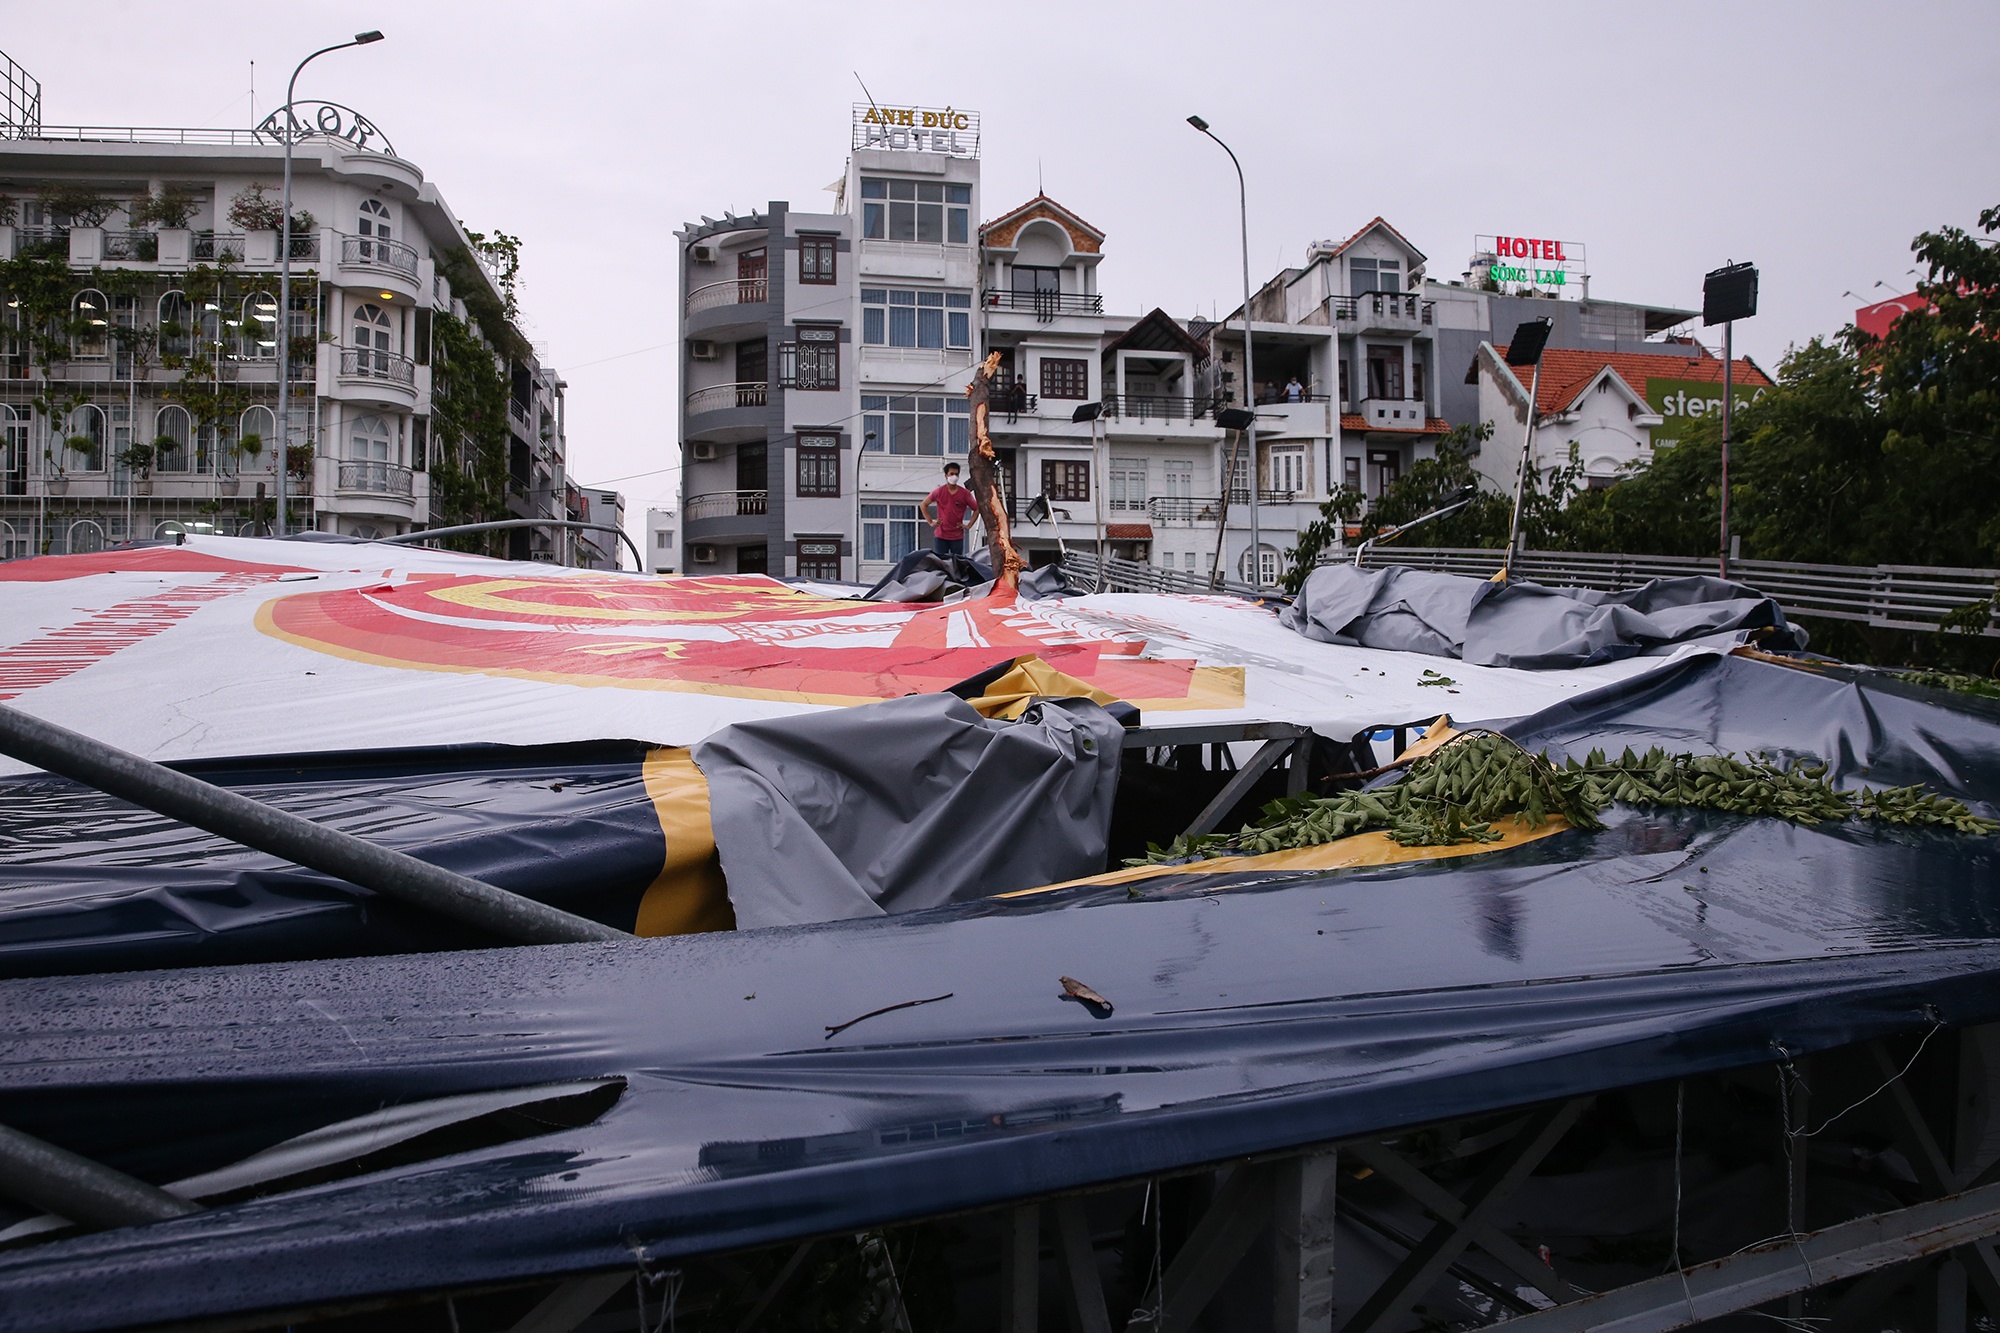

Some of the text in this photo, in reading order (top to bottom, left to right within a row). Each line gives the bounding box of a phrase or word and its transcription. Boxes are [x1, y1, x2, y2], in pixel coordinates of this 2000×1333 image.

[862, 106, 969, 130] ANH ĐỨC
[259, 105, 394, 156] FLOR
[865, 126, 966, 153] HOTEL
[1497, 236, 1566, 261] HOTEL
[1490, 263, 1566, 285] SÔNG LAM
[1655, 439, 1679, 448] CAMB
[39, 621, 177, 637] CÁC
